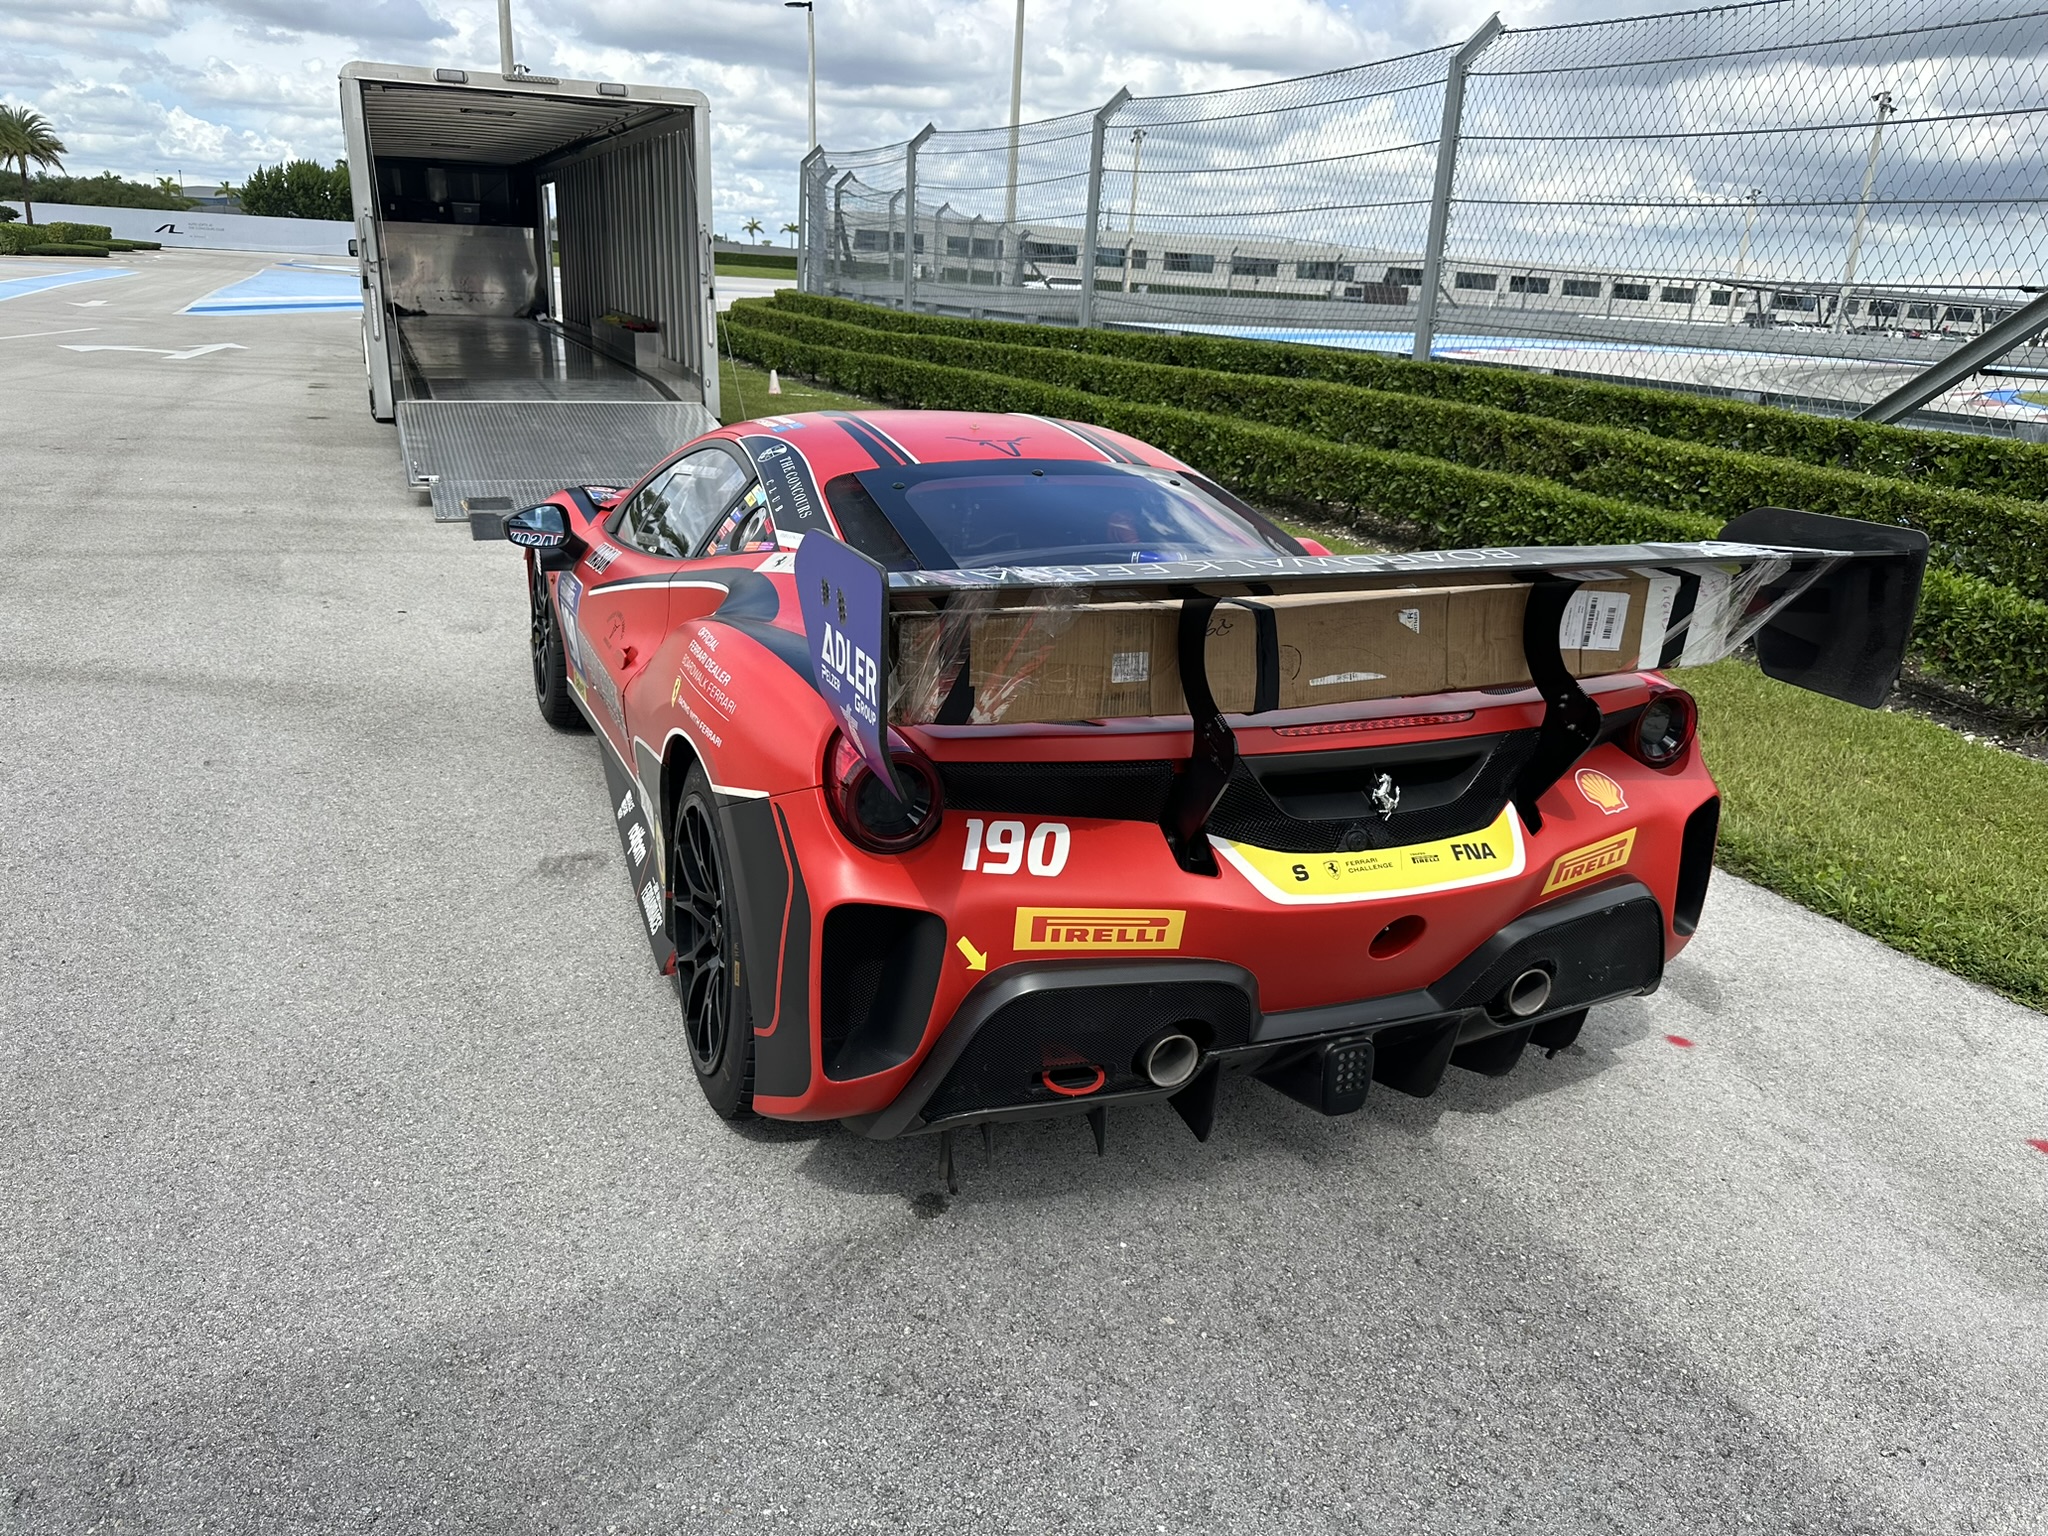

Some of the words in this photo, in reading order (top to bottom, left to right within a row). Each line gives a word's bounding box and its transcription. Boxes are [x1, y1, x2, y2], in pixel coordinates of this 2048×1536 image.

[766, 479, 784, 512] CLUB
[697, 626, 720, 652] OFFICIAL
[688, 639, 709, 665] FERRARI
[703, 657, 731, 687] DEALER
[821, 621, 877, 707] ADLER
[821, 663, 841, 693] PELZER
[681, 653, 709, 690] BOARDWALK
[705, 682, 737, 714] FERRARI
[854, 692, 877, 726] GROUP
[698, 721, 723, 748] FERRARI
[962, 818, 1071, 877] 190
[1345, 857, 1379, 867] FERRARI
[1450, 842, 1497, 861] FNA
[1551, 837, 1628, 885] PIRELLI
[1292, 864, 1310, 882] S
[1348, 862, 1394, 873] CHALLENGE
[1030, 916, 1171, 942] PIRELLI
